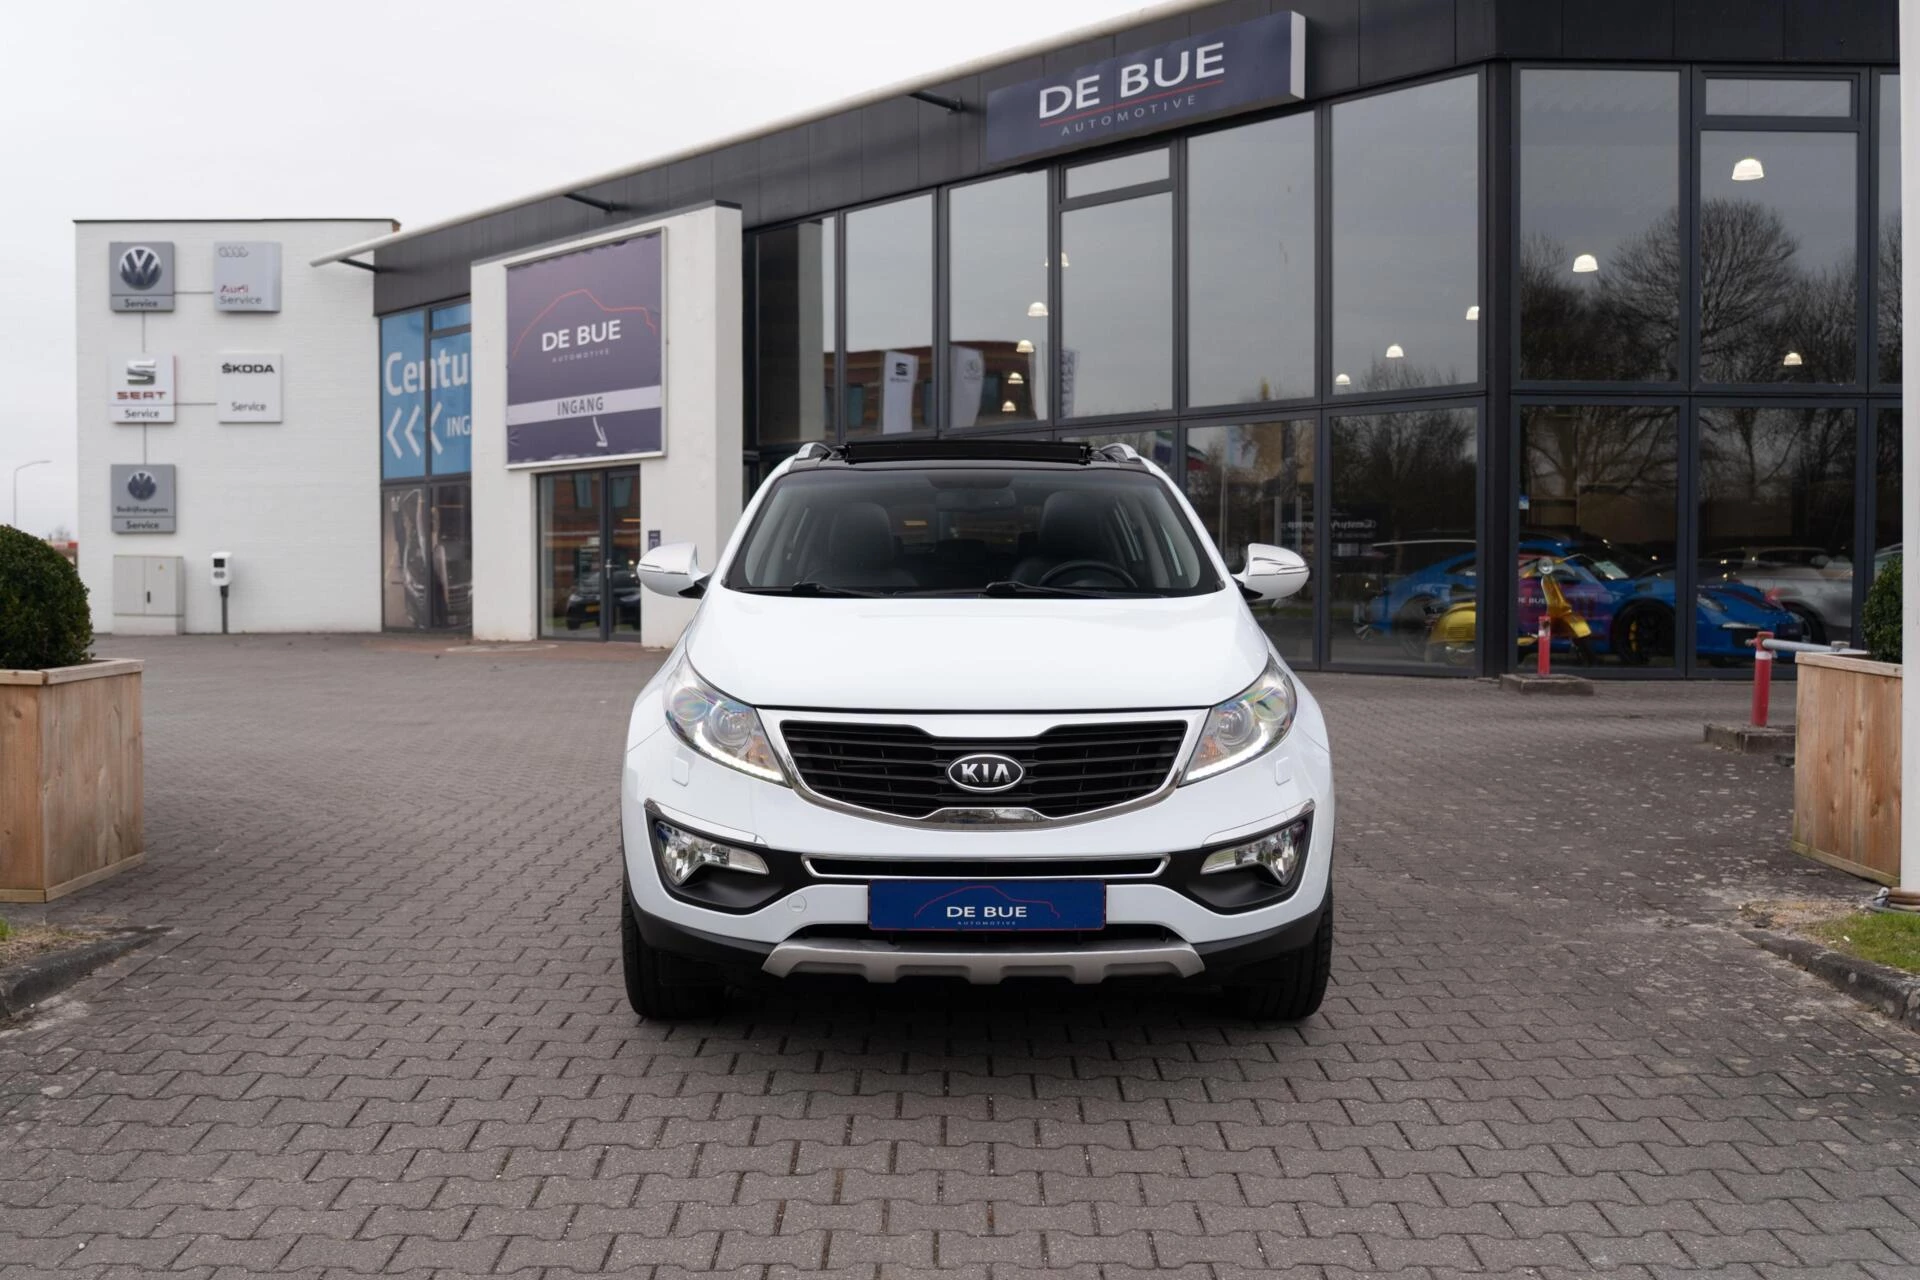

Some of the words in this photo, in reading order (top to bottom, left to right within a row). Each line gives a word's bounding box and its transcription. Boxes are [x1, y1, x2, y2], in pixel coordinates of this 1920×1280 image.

[1038, 74, 1100, 119] DE
[1119, 42, 1225, 98] BUE
[1061, 95, 1196, 136] AUTOMOTIVE
[124, 298, 159, 308] Service
[219, 295, 262, 305] Service
[542, 329, 570, 352] DE
[576, 319, 622, 346] BUE
[552, 348, 610, 363] AUTOMOTIVE
[221, 362, 275, 374] ŠKODA
[116, 391, 167, 401] SEAT
[231, 402, 267, 412] Service
[557, 396, 604, 416] INGANG
[124, 409, 160, 419] Service
[126, 520, 160, 530] Service
[960, 763, 1012, 783] KIA
[946, 906, 976, 917] DE
[983, 906, 1028, 917] BUE
